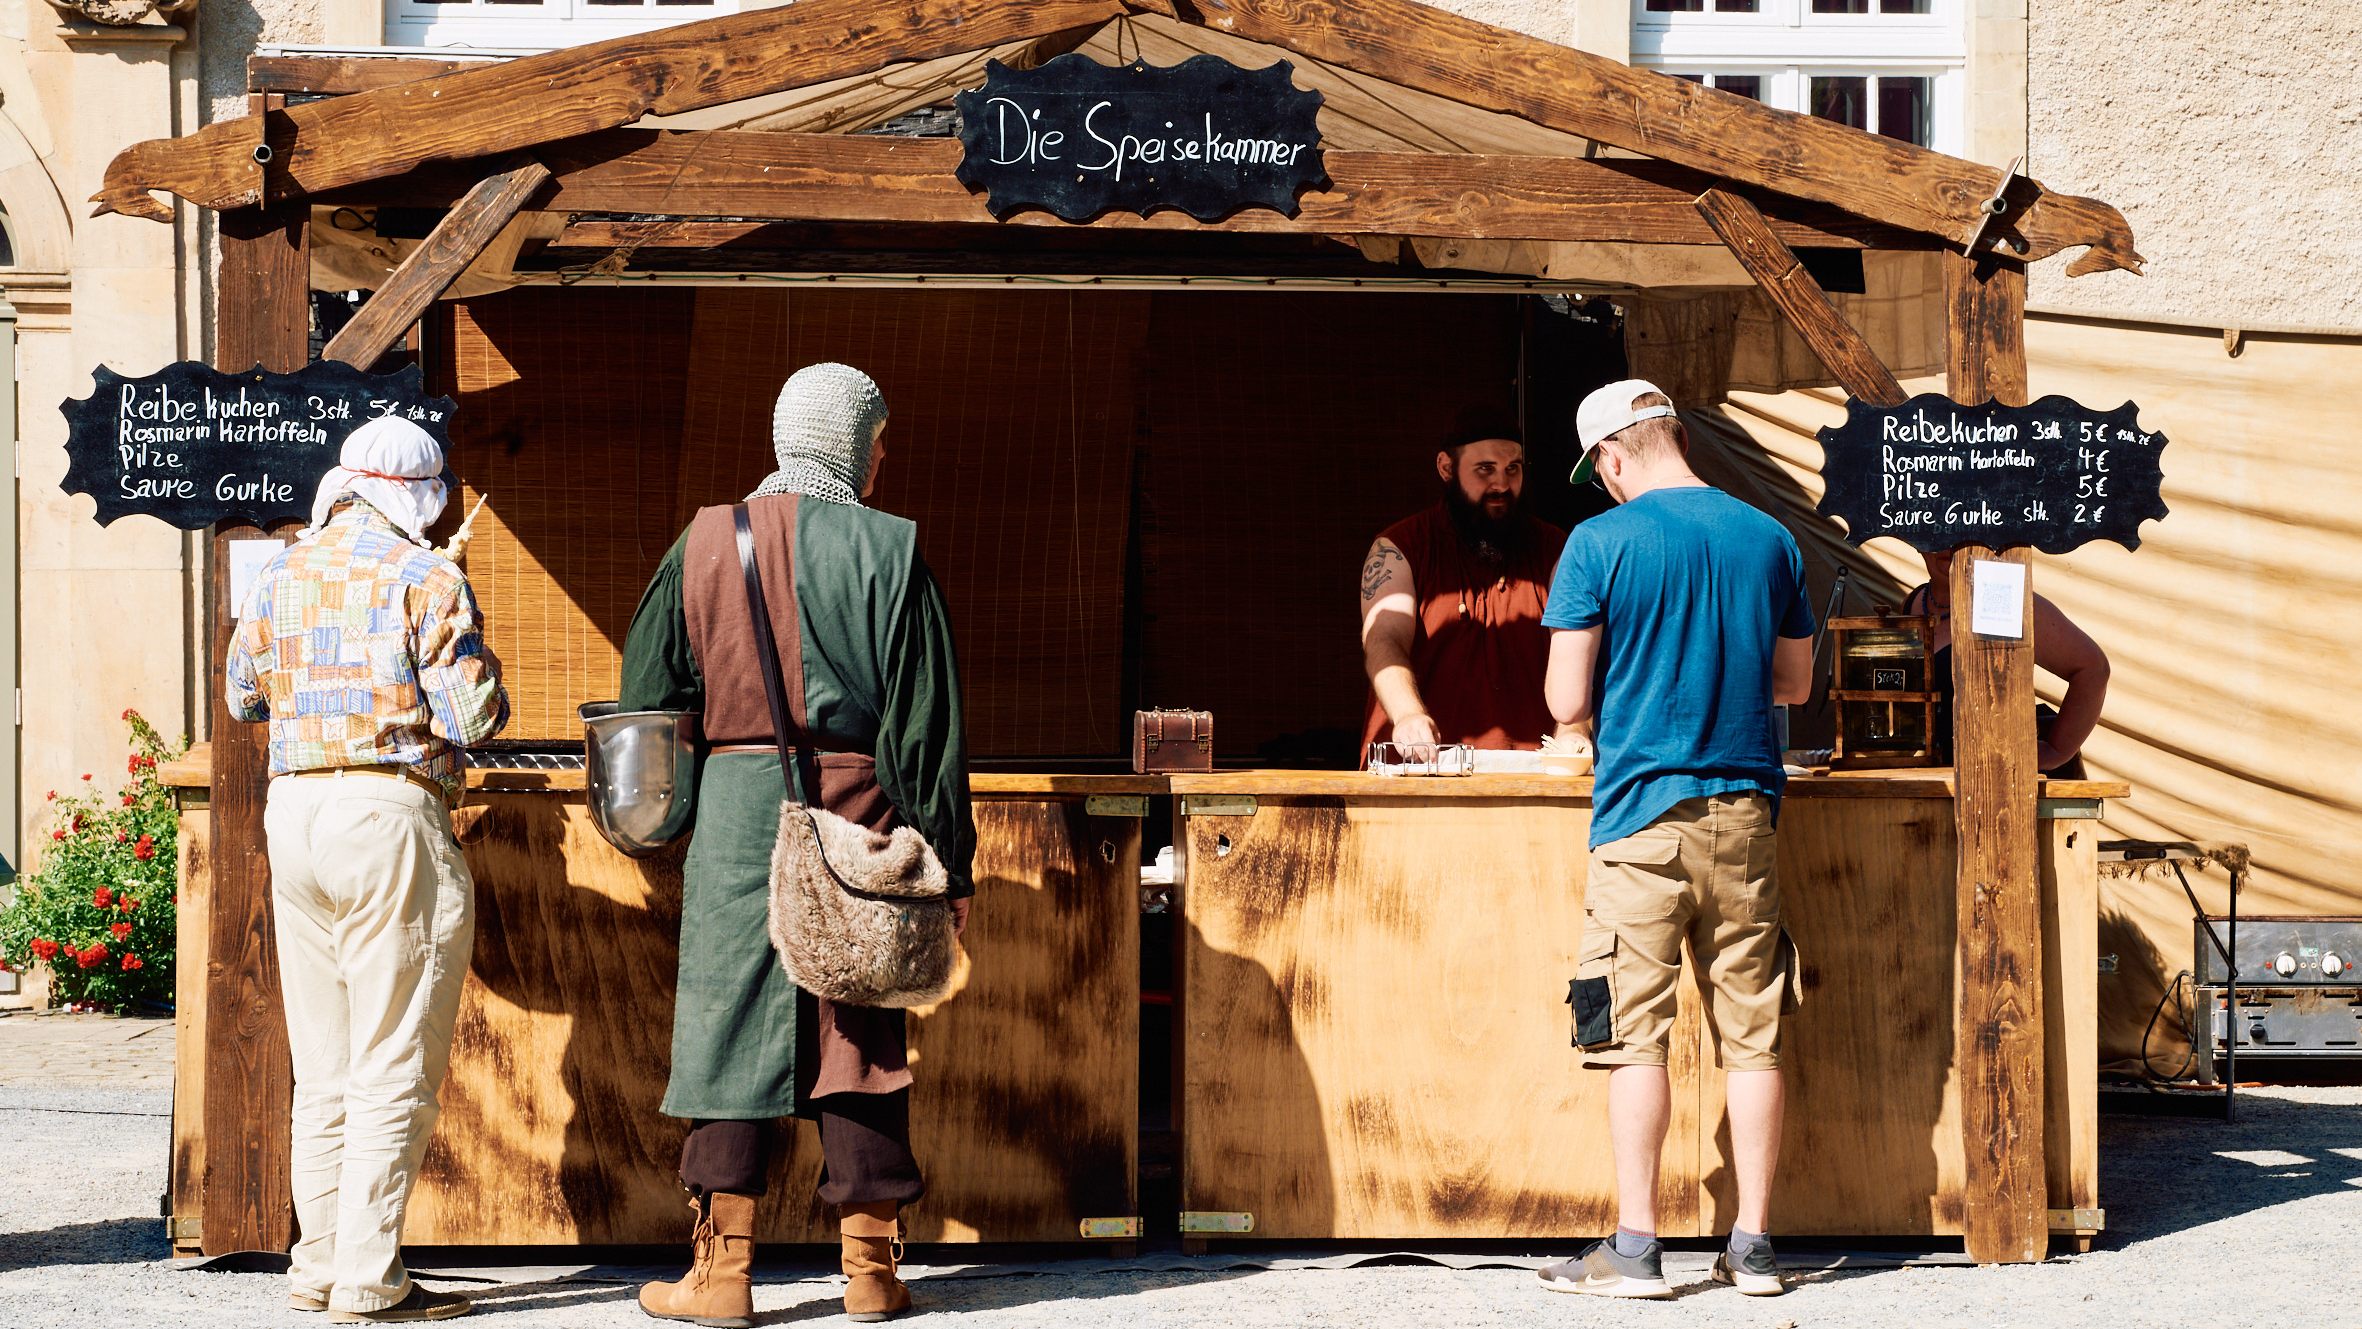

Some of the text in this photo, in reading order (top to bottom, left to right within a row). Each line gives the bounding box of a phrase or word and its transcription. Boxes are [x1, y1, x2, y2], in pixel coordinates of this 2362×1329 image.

[987, 97, 1308, 180] Die Speisekammer
[119, 417, 328, 446] Rosmarin Kartoffeln
[119, 444, 184, 471] Pilze
[1883, 445, 1963, 474] Rosmarin
[1971, 448, 2036, 470] Kartoffeln
[120, 473, 294, 503] Saure Gurke
[1883, 473, 1941, 501] Pilze
[1880, 502, 1936, 529] Saure
[1944, 501, 2004, 526] Gurke
